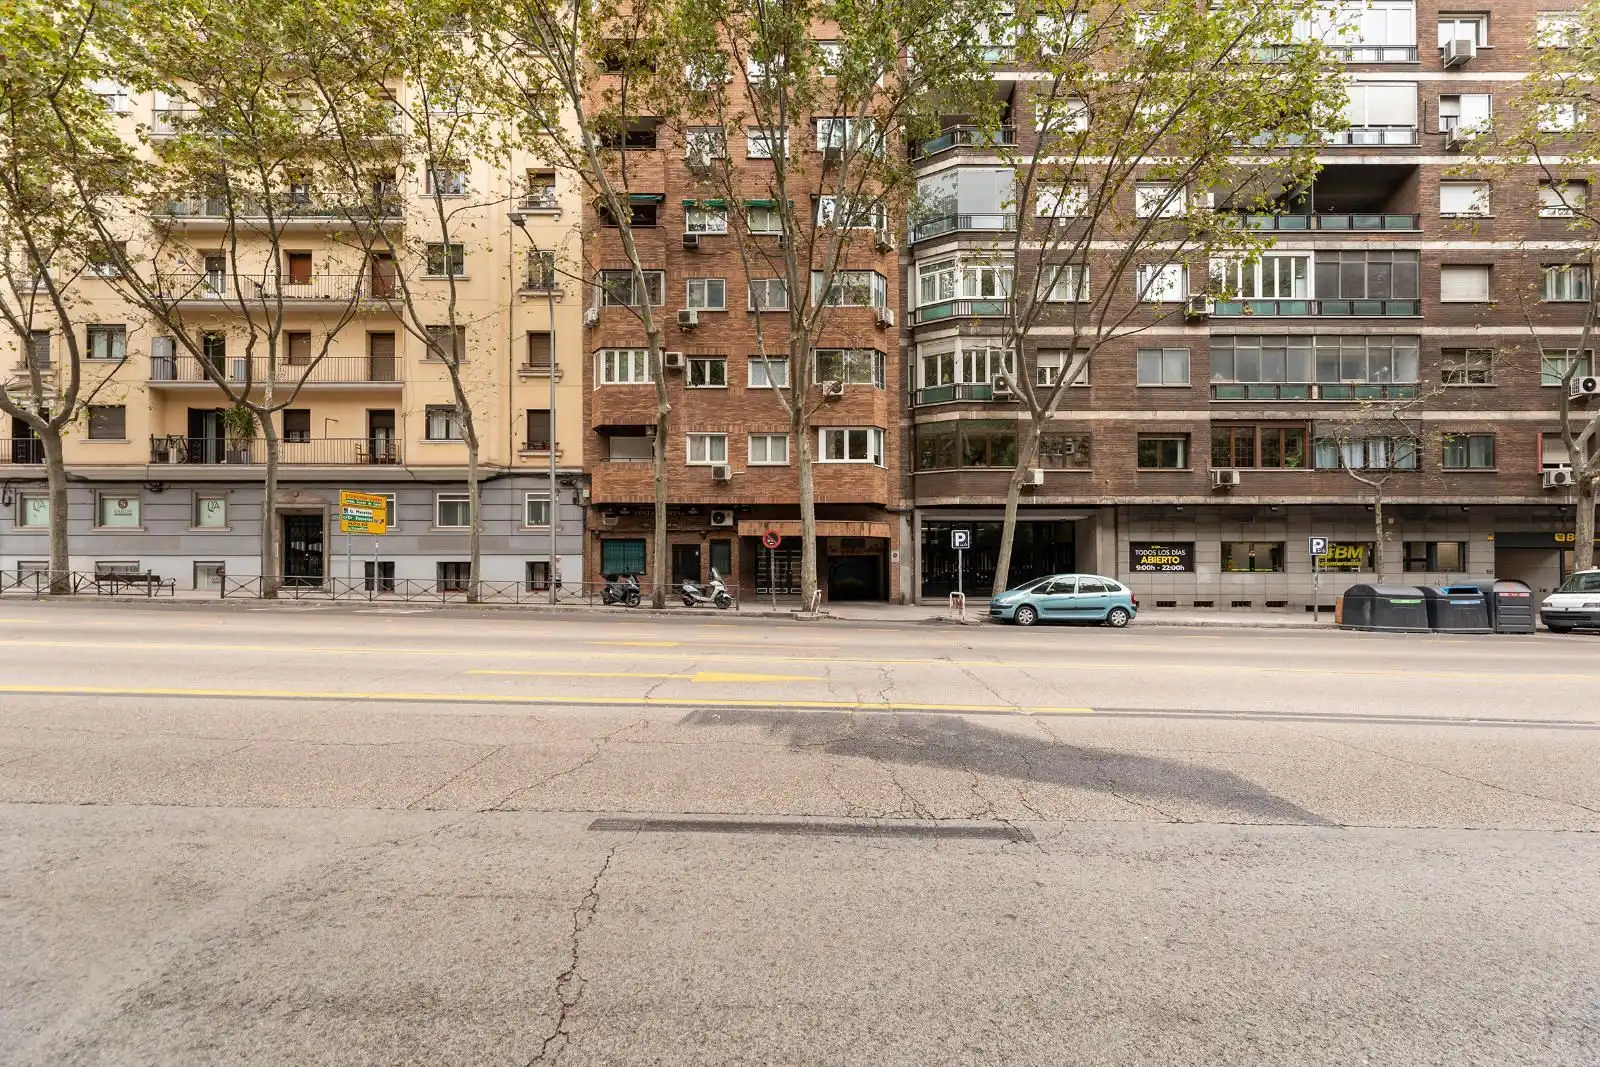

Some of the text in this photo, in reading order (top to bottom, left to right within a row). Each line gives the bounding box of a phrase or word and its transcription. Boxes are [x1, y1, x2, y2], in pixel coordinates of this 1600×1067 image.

[955, 532, 966, 546] P
[1312, 538, 1324, 553] P
[1171, 548, 1186, 556] DÍAS
[1334, 545, 1364, 559] BM
[1140, 555, 1180, 564] ABIERTO
